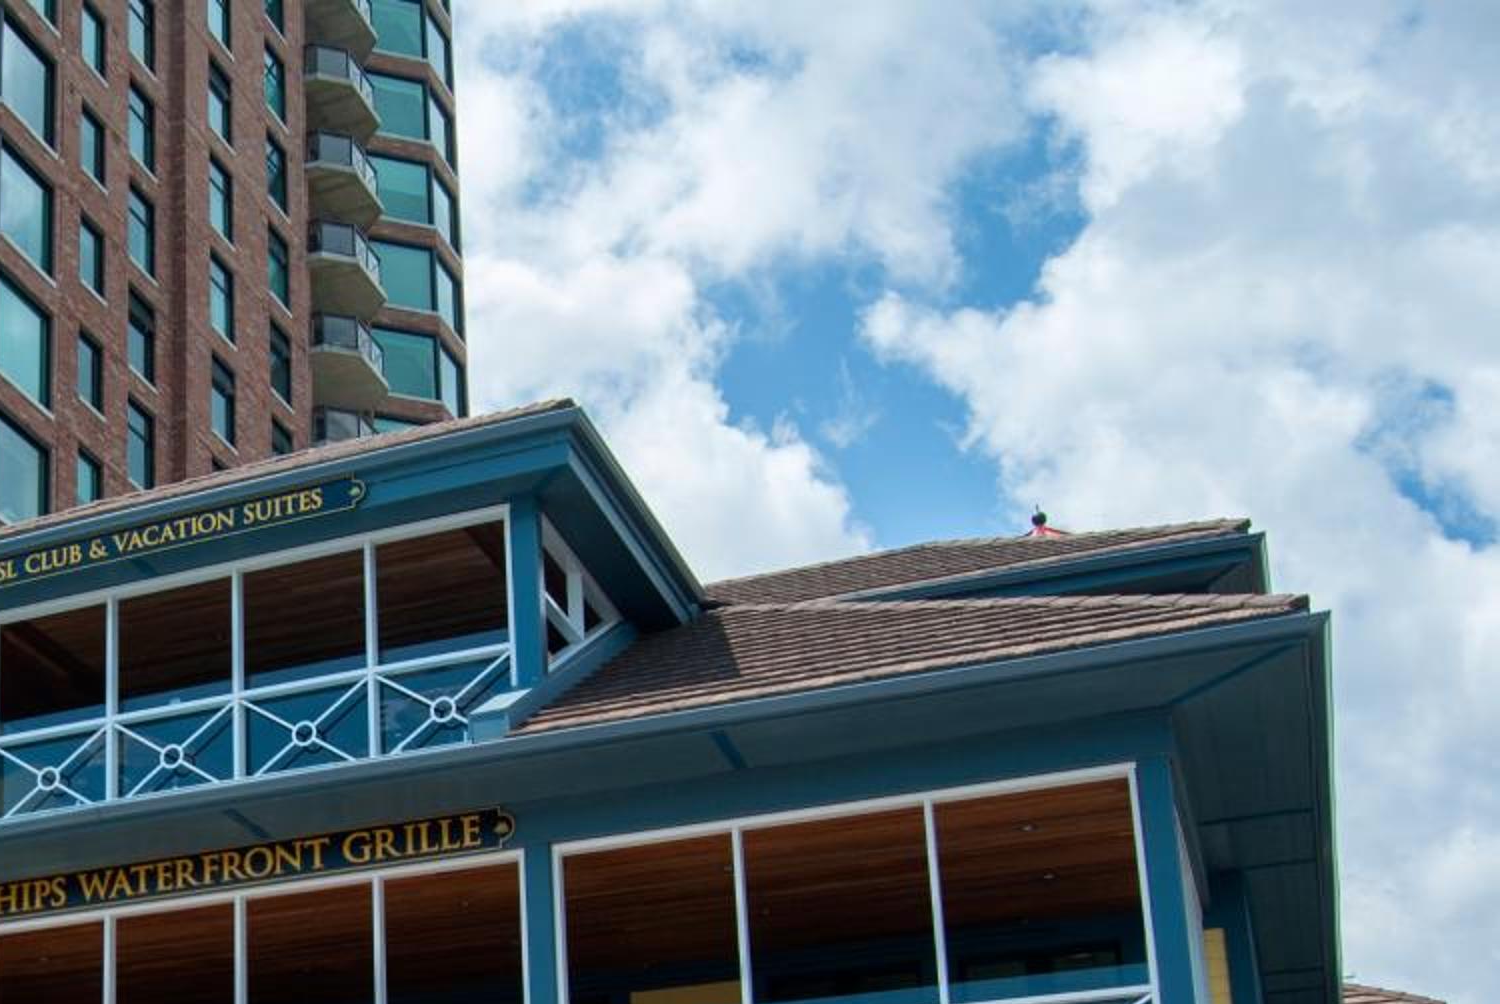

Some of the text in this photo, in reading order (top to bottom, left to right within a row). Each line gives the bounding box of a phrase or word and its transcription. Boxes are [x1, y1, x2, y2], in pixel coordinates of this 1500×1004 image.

[25, 543, 83, 574] CLUB
[88, 538, 108, 559] &
[112, 508, 235, 553] VACATION
[243, 488, 324, 525] SUITES
[77, 837, 331, 901] WATERFRONT
[341, 814, 483, 864] GRILLE
